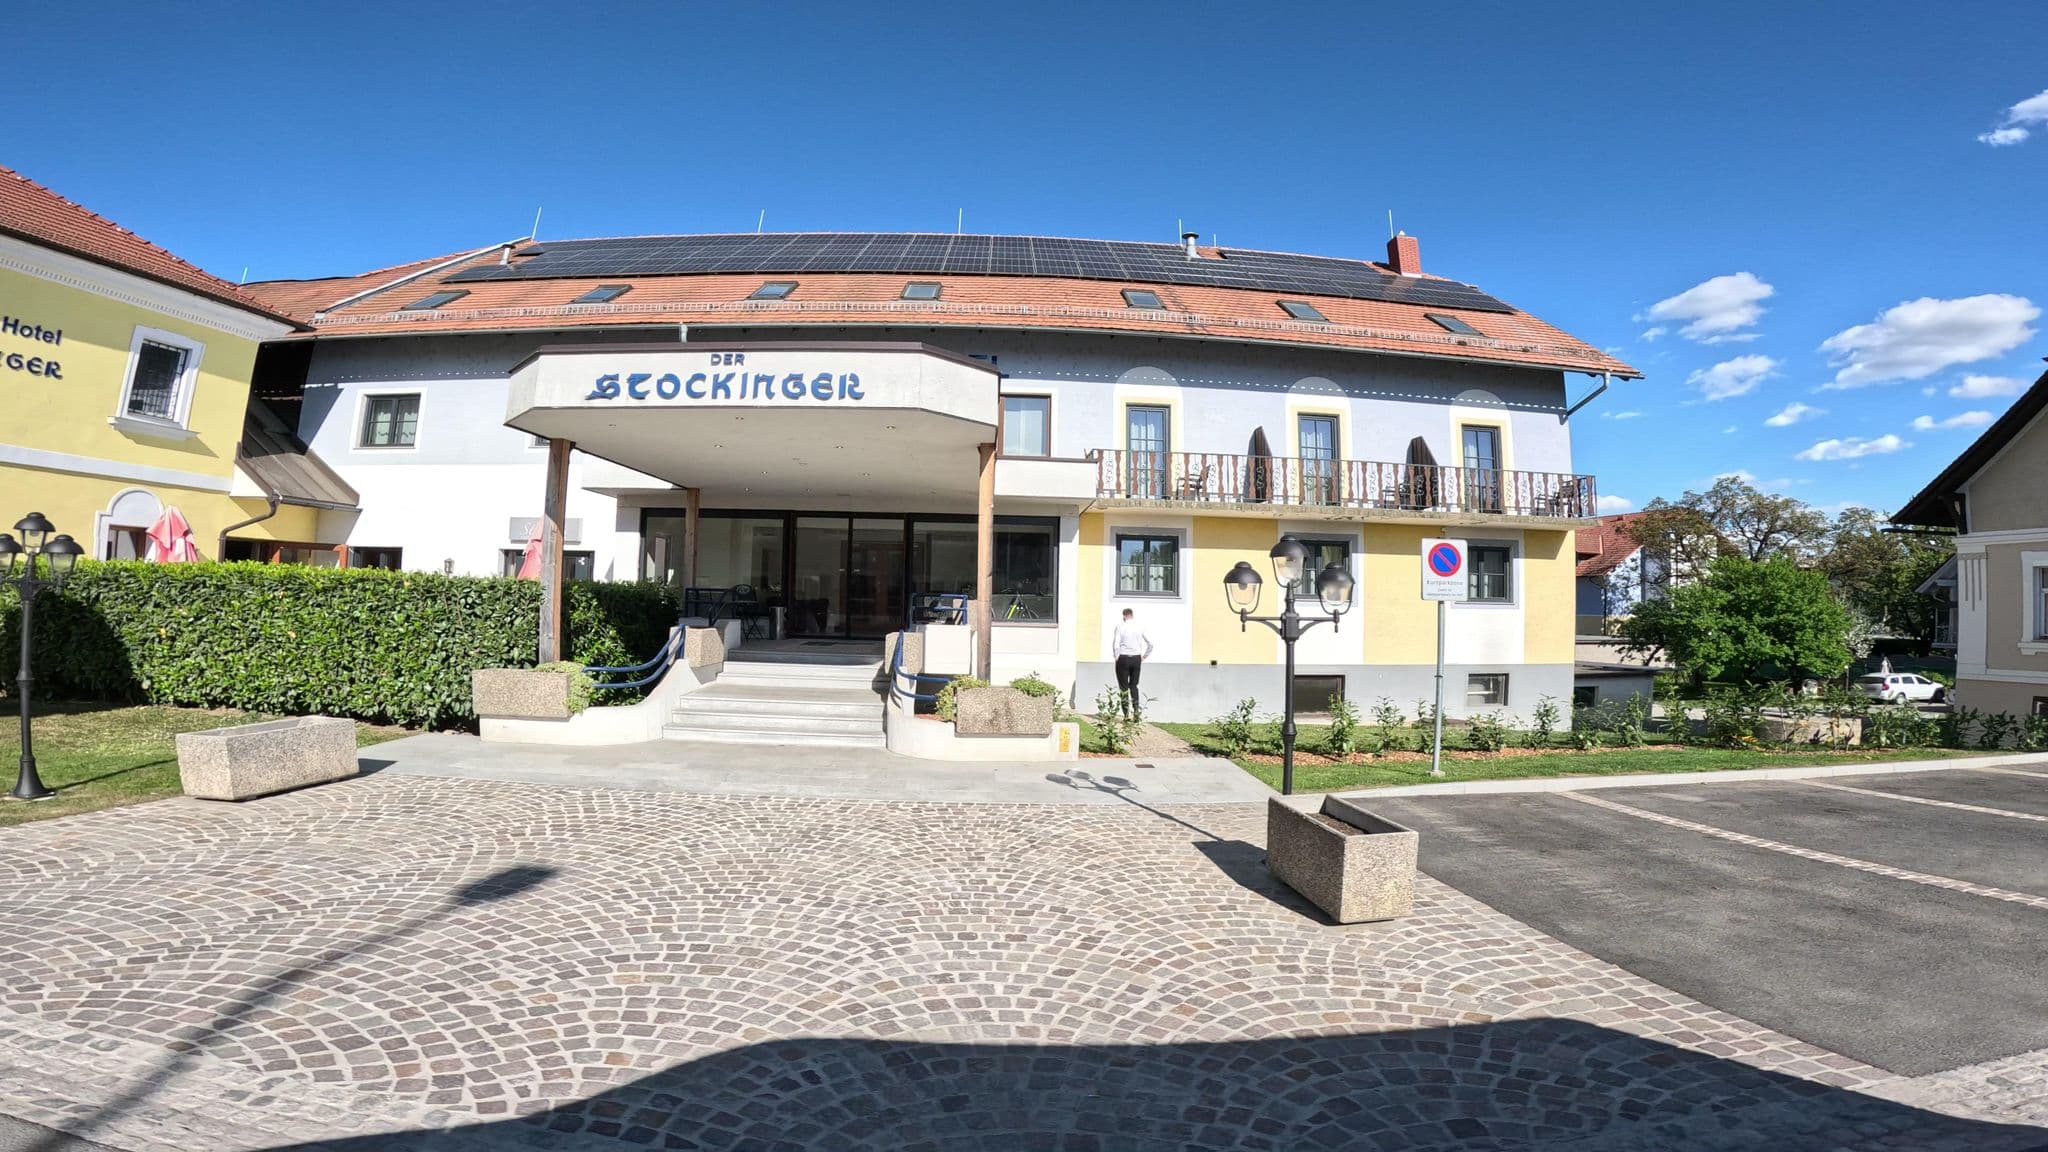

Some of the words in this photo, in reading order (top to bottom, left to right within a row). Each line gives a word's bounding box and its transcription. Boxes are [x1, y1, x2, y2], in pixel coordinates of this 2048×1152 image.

[2, 316, 62, 346] Hotel
[0, 351, 63, 380] GER
[710, 353, 745, 367] DER
[584, 371, 866, 401] STOCKINGER
